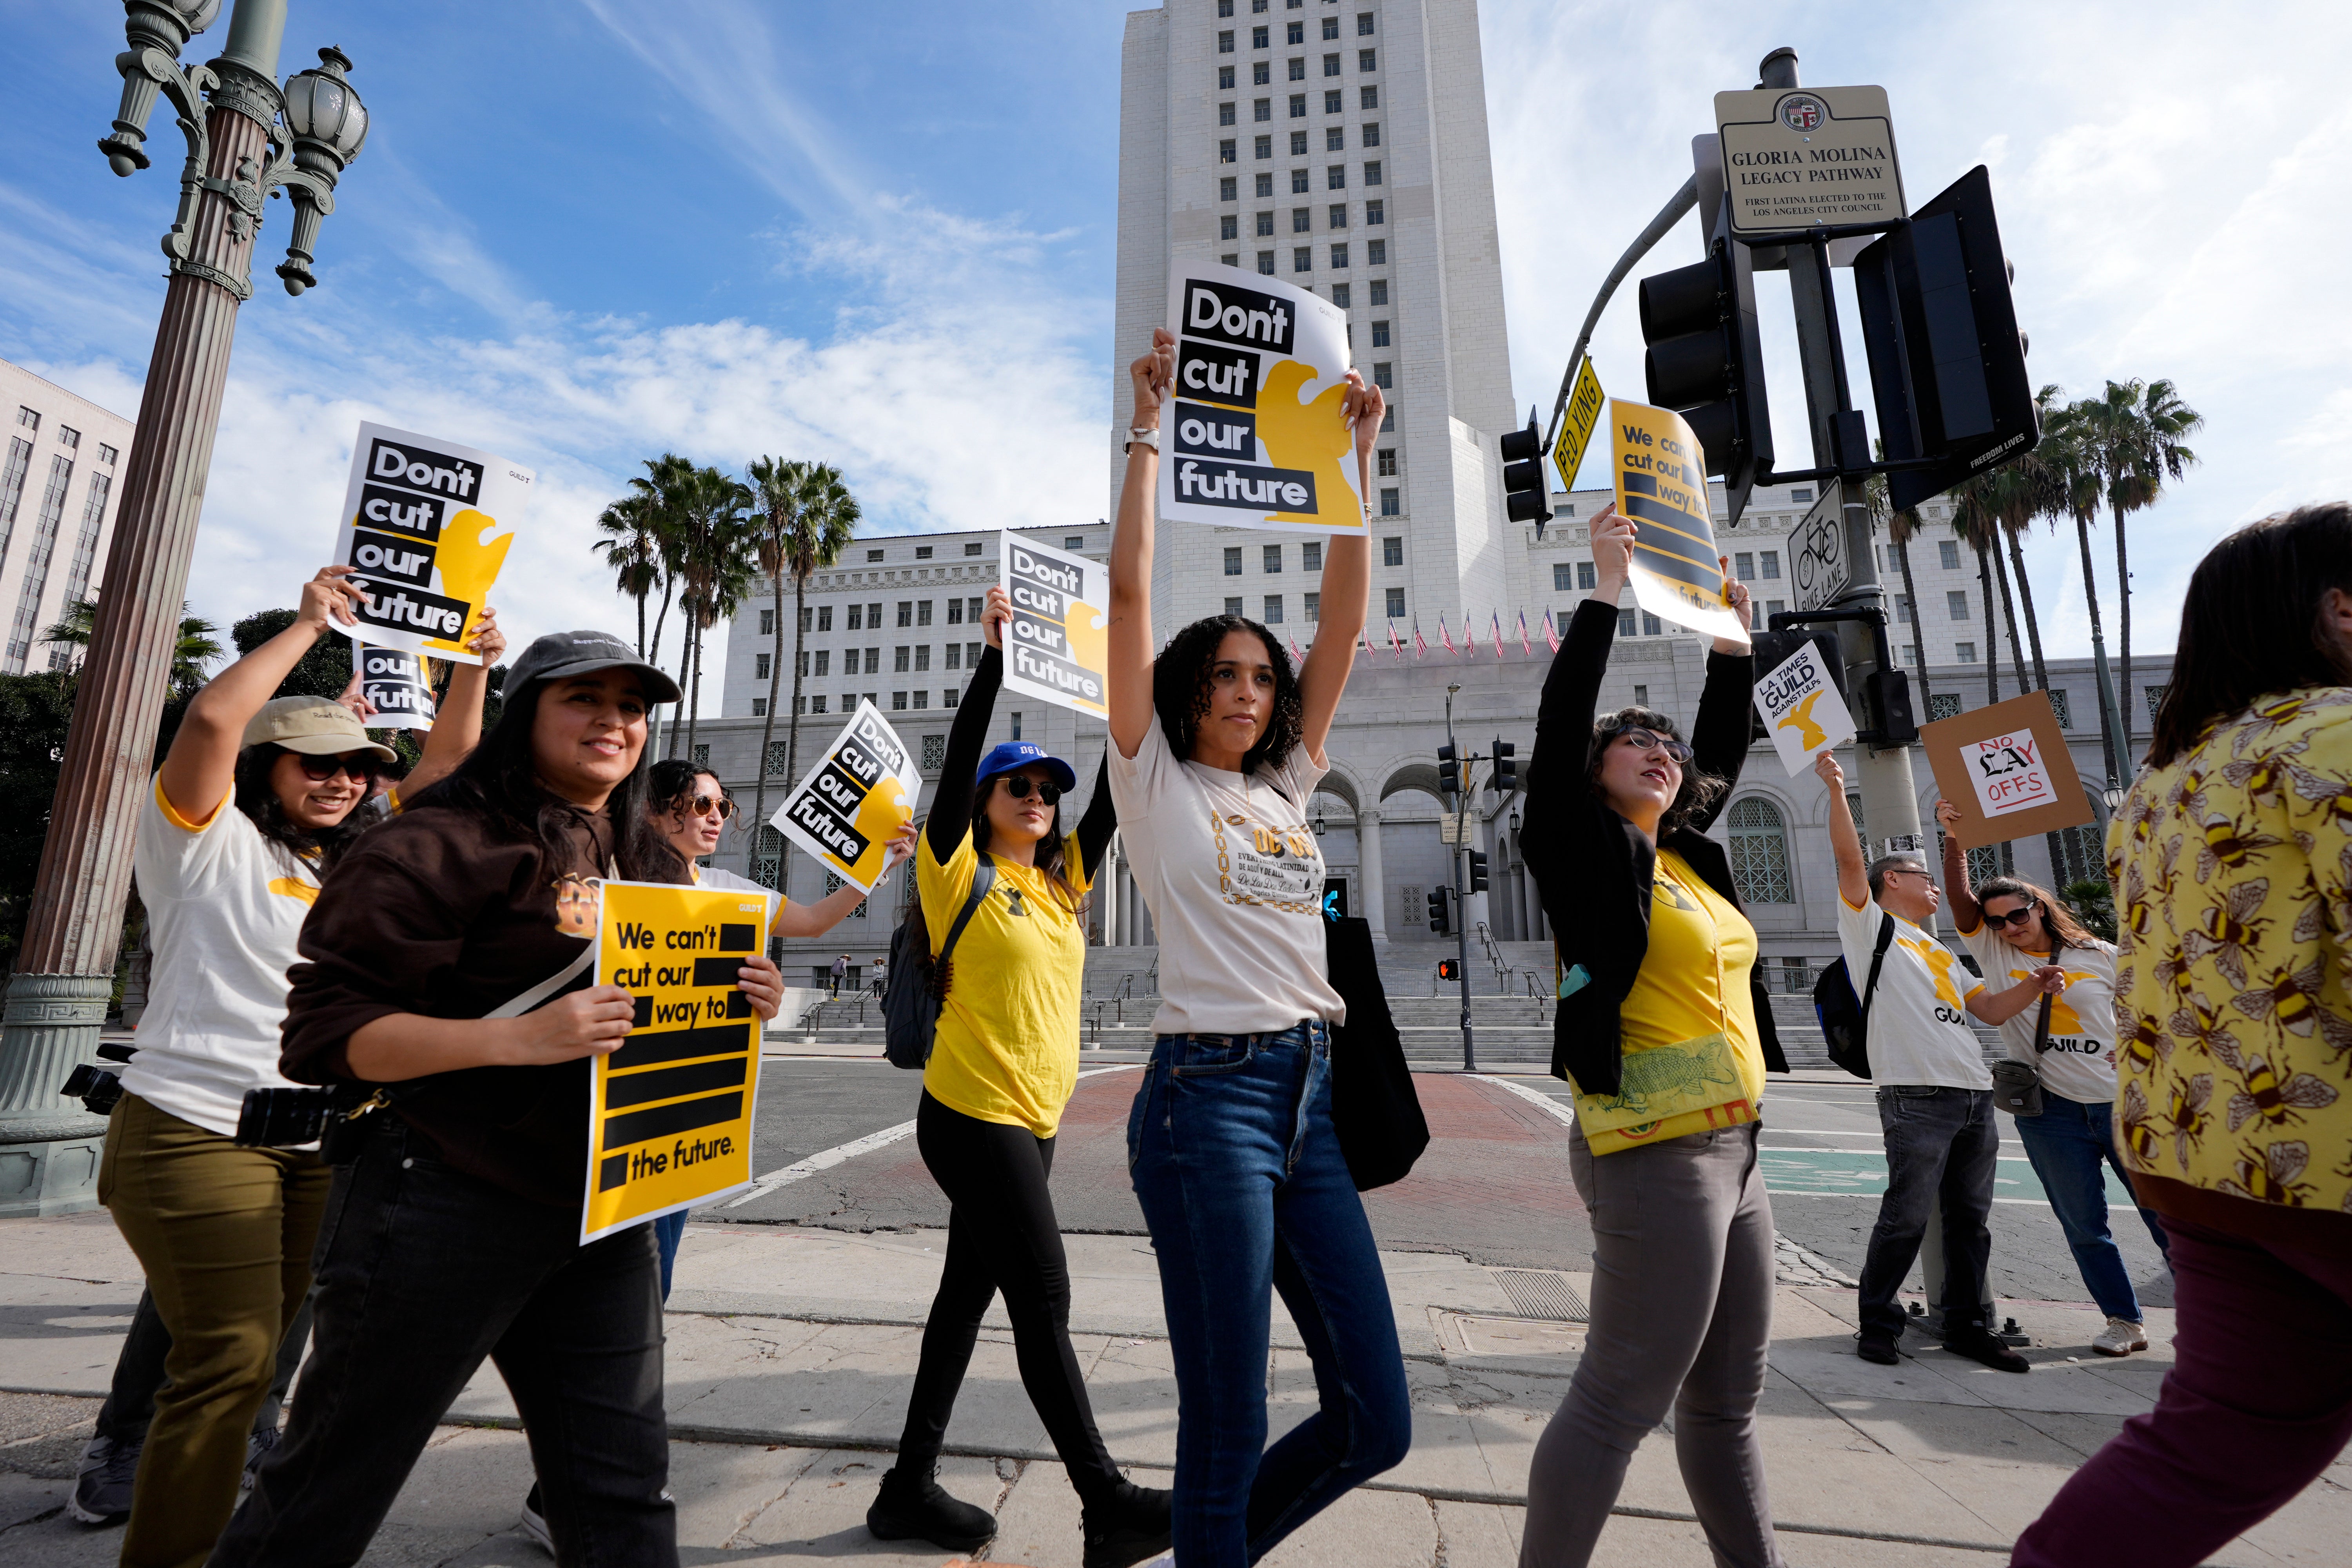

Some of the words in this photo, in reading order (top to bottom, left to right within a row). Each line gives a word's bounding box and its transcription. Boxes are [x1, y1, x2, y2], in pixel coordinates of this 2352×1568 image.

[1732, 151, 1803, 166] GLORIA
[1809, 147, 1886, 163] MOLINA
[1740, 170, 1801, 185] LEGACY
[1809, 166, 1883, 182] PATHWAY
[1745, 197, 1770, 206] FIRST
[1773, 196, 1807, 205] LATINA
[1809, 194, 1850, 204] ELECTED
[1867, 192, 1886, 201] THE
[1753, 208, 1771, 217] LOS
[1773, 207, 1815, 216] ANGELES
[1817, 205, 1839, 214] CITY
[1841, 203, 1883, 212] COUNCIL
[1190, 287, 1288, 344] Don't
[1319, 307, 1336, 320] GUILD
[1183, 358, 1249, 396] cut
[1180, 418, 1250, 451] our
[1559, 429, 1578, 478] PED
[1572, 376, 1597, 439] XING
[1622, 424, 1653, 447] We
[1623, 453, 1653, 470] cut
[1657, 460, 1681, 479] our
[1970, 445, 2004, 469] FREEDOM
[2004, 433, 2025, 450] LIVES
[374, 445, 475, 498] Don't
[509, 471, 525, 481] GUILD
[1180, 461, 1308, 506] future
[365, 498, 434, 532] cut
[1659, 485, 1690, 513] way
[1693, 495, 1704, 515] to
[356, 543, 430, 577] our
[1014, 549, 1079, 592] Don't
[1014, 587, 1058, 615] cut
[1802, 586, 1820, 612] BIKE
[1821, 562, 1843, 599] LANE
[348, 580, 462, 633] future
[1015, 619, 1063, 649] our
[367, 657, 418, 677] our
[1016, 647, 1099, 698] future
[1759, 680, 1777, 696] L.A.
[1777, 653, 1808, 681] TIMES
[1766, 664, 1815, 708] GUILD
[1772, 690, 1802, 719] AGAINST
[1802, 679, 1821, 693] ULPs
[858, 716, 903, 771] Don't
[1979, 737, 2013, 752] NO
[1980, 739, 2035, 779] LAY
[840, 746, 878, 782] cut
[818, 773, 858, 808] our
[1988, 772, 2042, 801] OFFS
[792, 797, 860, 858] future
[1237, 873, 1250, 885] De
[1247, 864, 1259, 873] AQUÍ
[1276, 862, 1310, 873] LATINIDAD
[739, 904, 756, 912] GUILD
[1250, 887, 1271, 897] Angeles
[616, 922, 655, 949] We
[666, 924, 716, 949] can't
[613, 962, 652, 988] cut
[657, 967, 691, 987] our
[656, 1002, 701, 1030] way
[707, 996, 725, 1019] to
[632, 1147, 668, 1182] the
[673, 1136, 735, 1171] future.
